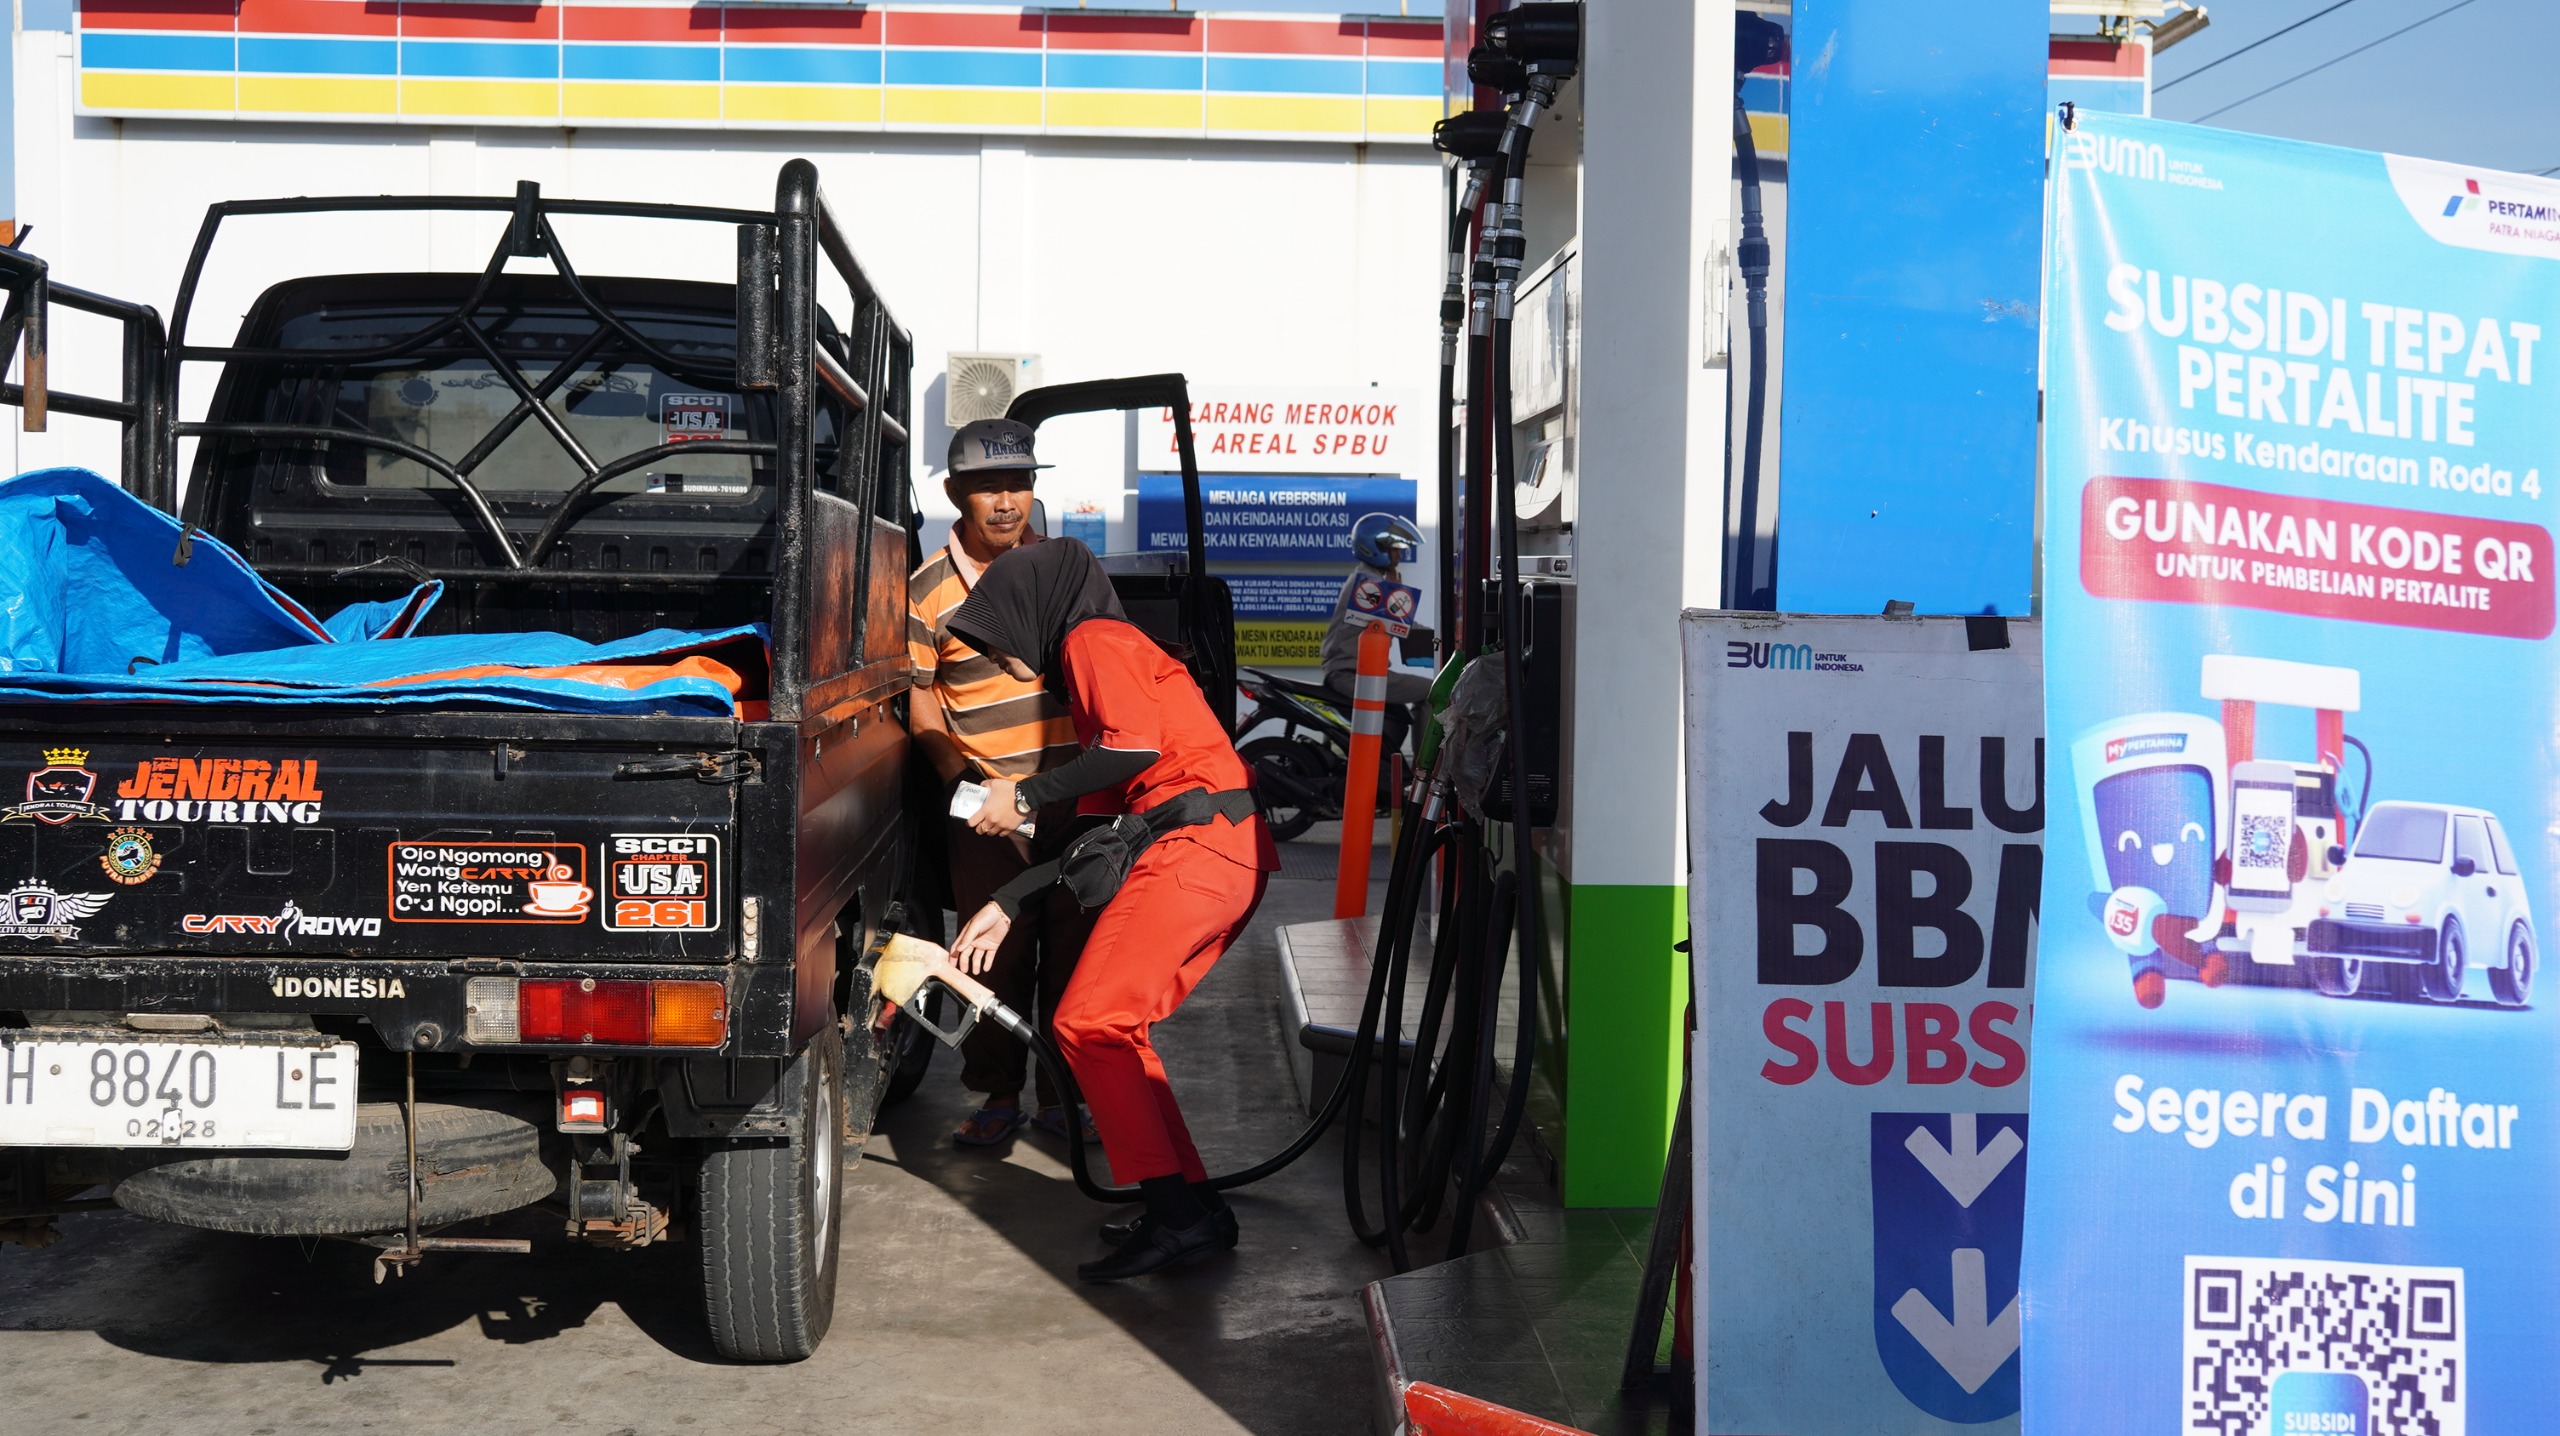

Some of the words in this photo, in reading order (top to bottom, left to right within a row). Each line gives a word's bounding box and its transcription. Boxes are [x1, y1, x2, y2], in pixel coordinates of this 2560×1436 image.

[2168, 160, 2204, 174] UNTUK
[2168, 172, 2224, 190] INDONESIA
[2489, 222, 2521, 238] PATRA
[2103, 264, 2346, 361] SUBSIDI
[2361, 302, 2541, 385] TEPAT
[668, 396, 723, 406] SCCI
[2178, 345, 2475, 447] PERTALITE
[671, 411, 720, 430] USA
[1285, 404, 1397, 426] MEROKOK
[1211, 433, 1297, 454] AREAL
[1313, 434, 1388, 455] SPBU
[2100, 417, 2227, 461] Khusus
[2234, 432, 2418, 486] Kendaraan
[2429, 456, 2512, 497] Roda
[2521, 469, 2542, 499] 4
[1209, 490, 1266, 505] MENJAGA
[1269, 491, 1346, 506] KEBERSIHAN
[1205, 512, 1230, 526] DAN
[1232, 512, 1302, 526] KEINDAHAN
[1305, 513, 1349, 527] LOKASI
[1239, 533, 1323, 547] KENYAMANAN
[2105, 496, 2336, 559] GUNAKAN
[2350, 523, 2461, 575] KODE
[2474, 537, 2534, 583] QR
[2156, 552, 2245, 583] UNTUK
[2252, 561, 2375, 599] PEMBELIAN
[2381, 577, 2491, 611] PERTALITE
[1241, 630, 1268, 642] MESIN
[1236, 645, 1269, 657] WAKTU
[1271, 645, 1307, 657] MENGISI
[1815, 653, 1847, 662] UNTUK
[1814, 663, 1864, 672] INDONESIA
[117, 757, 323, 801] JENDRAL
[56, 802, 87, 811] TOURING
[115, 799, 322, 823] TOURING
[615, 839, 707, 854] SCCI
[401, 847, 436, 864] Ojo
[440, 848, 543, 868] Ngomong
[397, 863, 461, 880] Wong
[461, 868, 546, 880] CARRY
[619, 864, 703, 895] USA
[397, 880, 432, 894] Yen
[438, 880, 513, 895] Ketemu
[18, 926, 38, 935] TEAM
[183, 914, 282, 934] CARRY
[298, 916, 382, 937] ROWO
[7, 1047, 35, 1104] H
[90, 1048, 217, 1108] 8840
[276, 1051, 337, 1111] LE
[2113, 1074, 2327, 1149] Segera
[2350, 1087, 2518, 1149] Daftar
[2229, 1156, 2287, 1219] di
[2303, 1160, 2416, 1227] Sini
[2284, 1412, 2356, 1432] SUBSIDI
